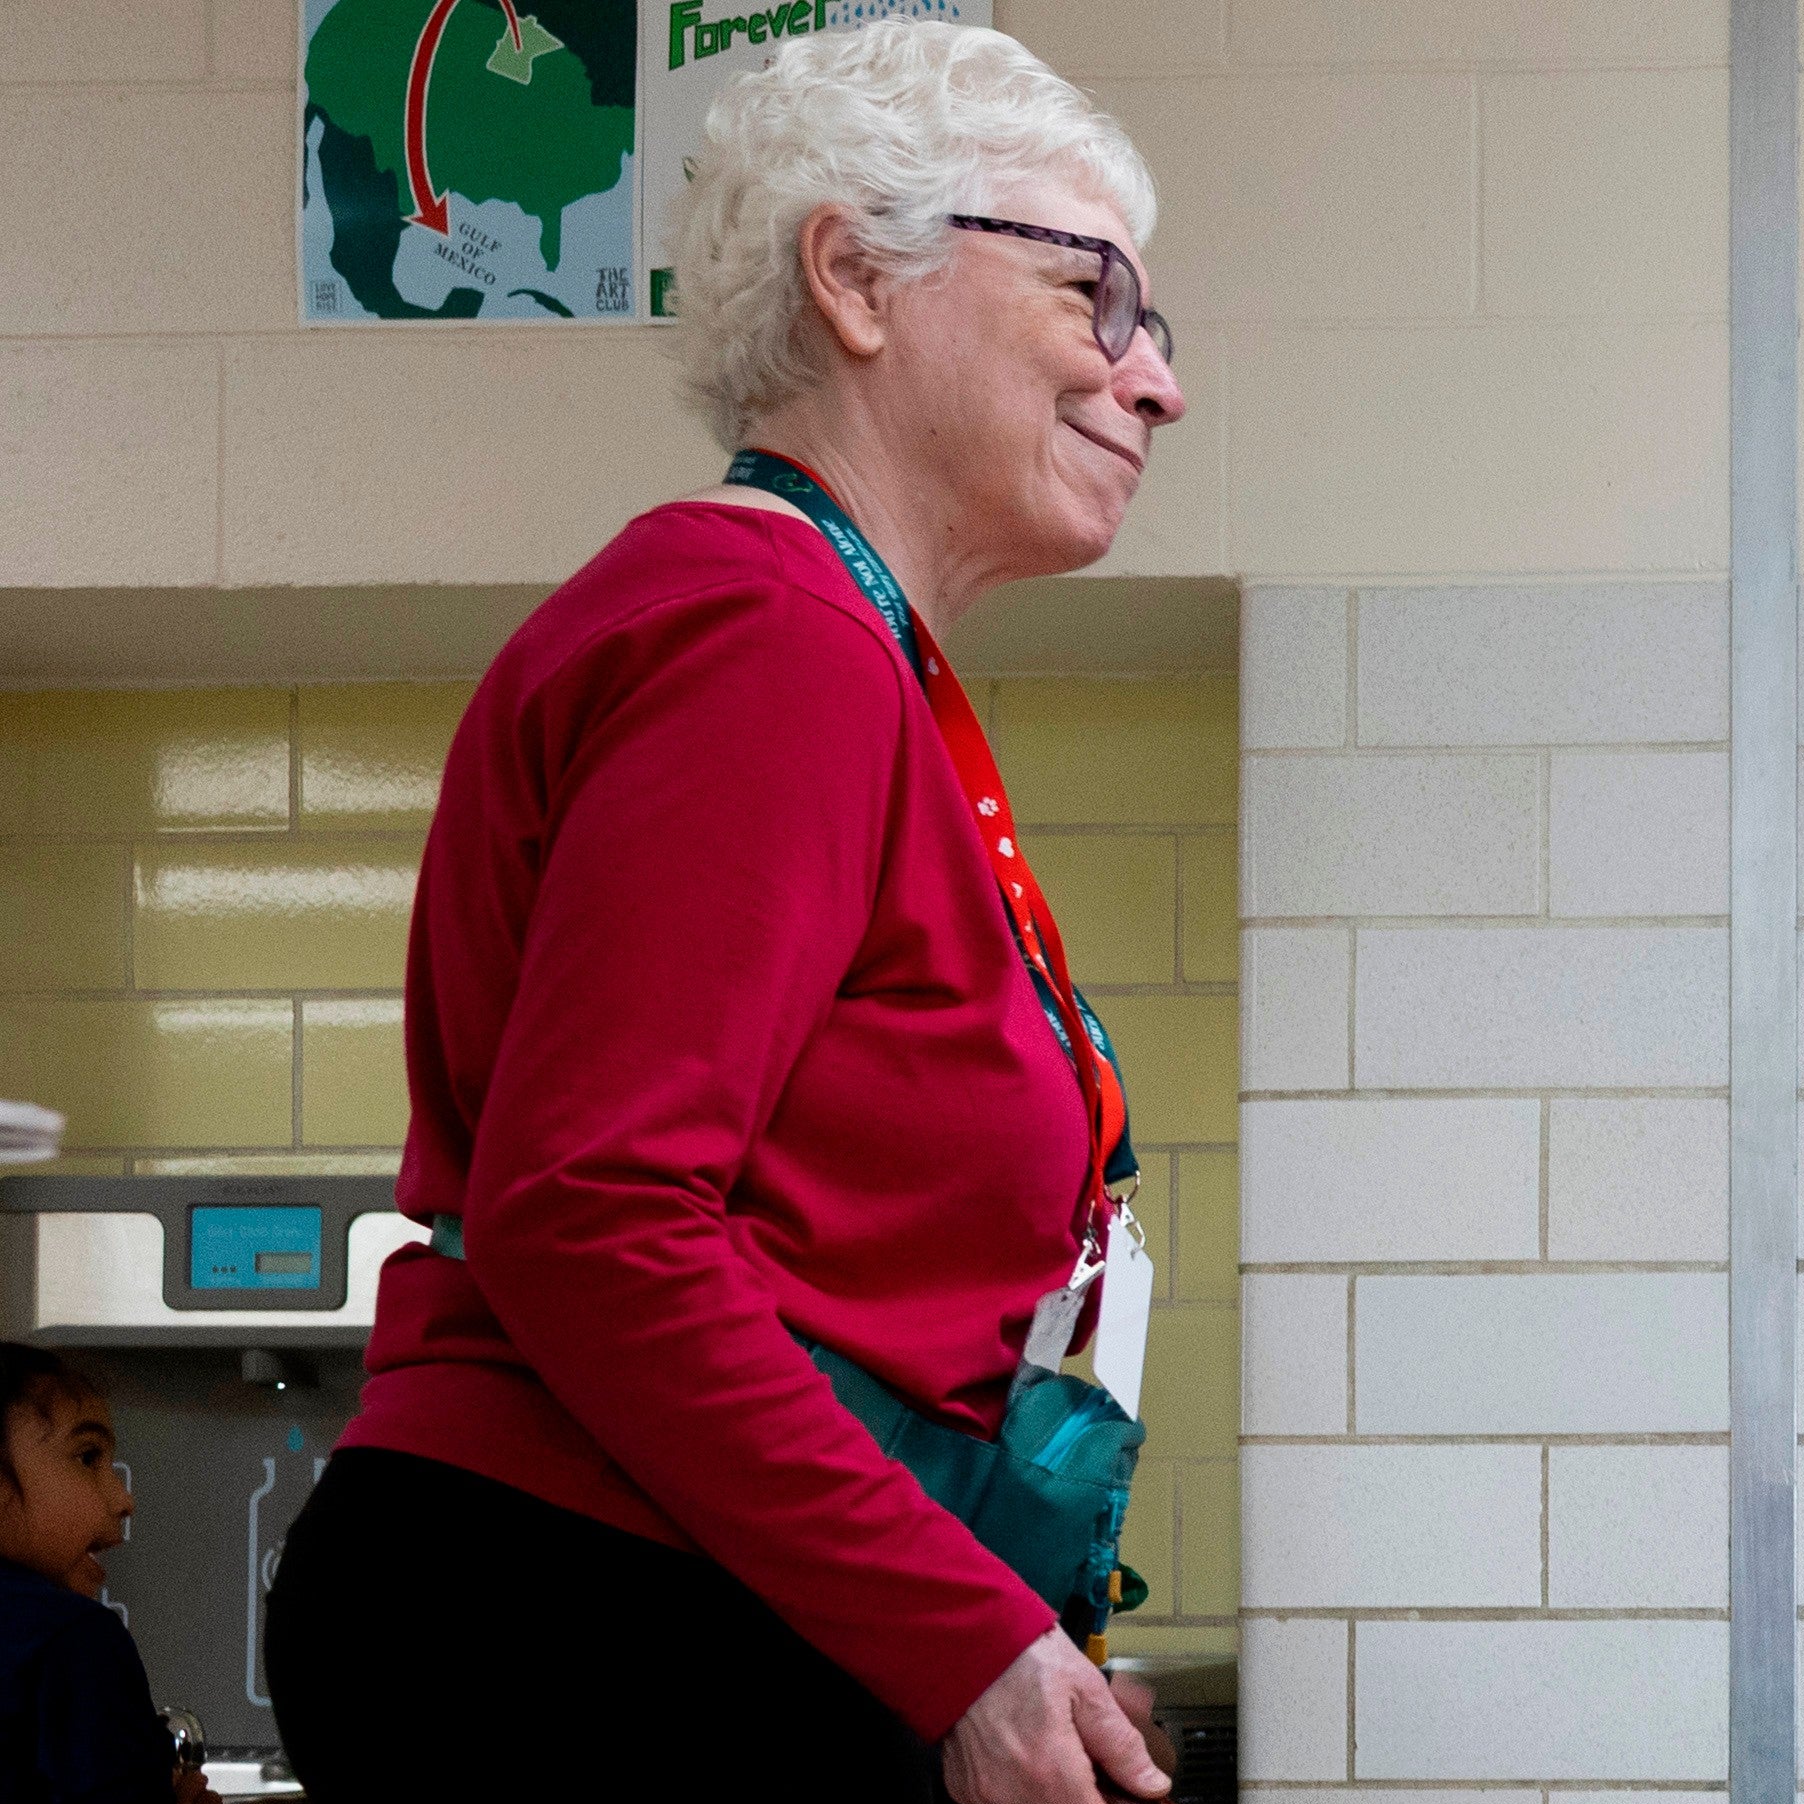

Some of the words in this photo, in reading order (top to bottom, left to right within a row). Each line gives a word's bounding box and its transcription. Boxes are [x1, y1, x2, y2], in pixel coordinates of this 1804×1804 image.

[669, 0, 842, 71] Forever
[459, 222, 501, 251] GULF
[461, 241, 485, 259] OF
[434, 242, 496, 286] MEXICO
[597, 267, 628, 282] THE
[596, 282, 629, 299] ART
[596, 299, 629, 311] CLUB
